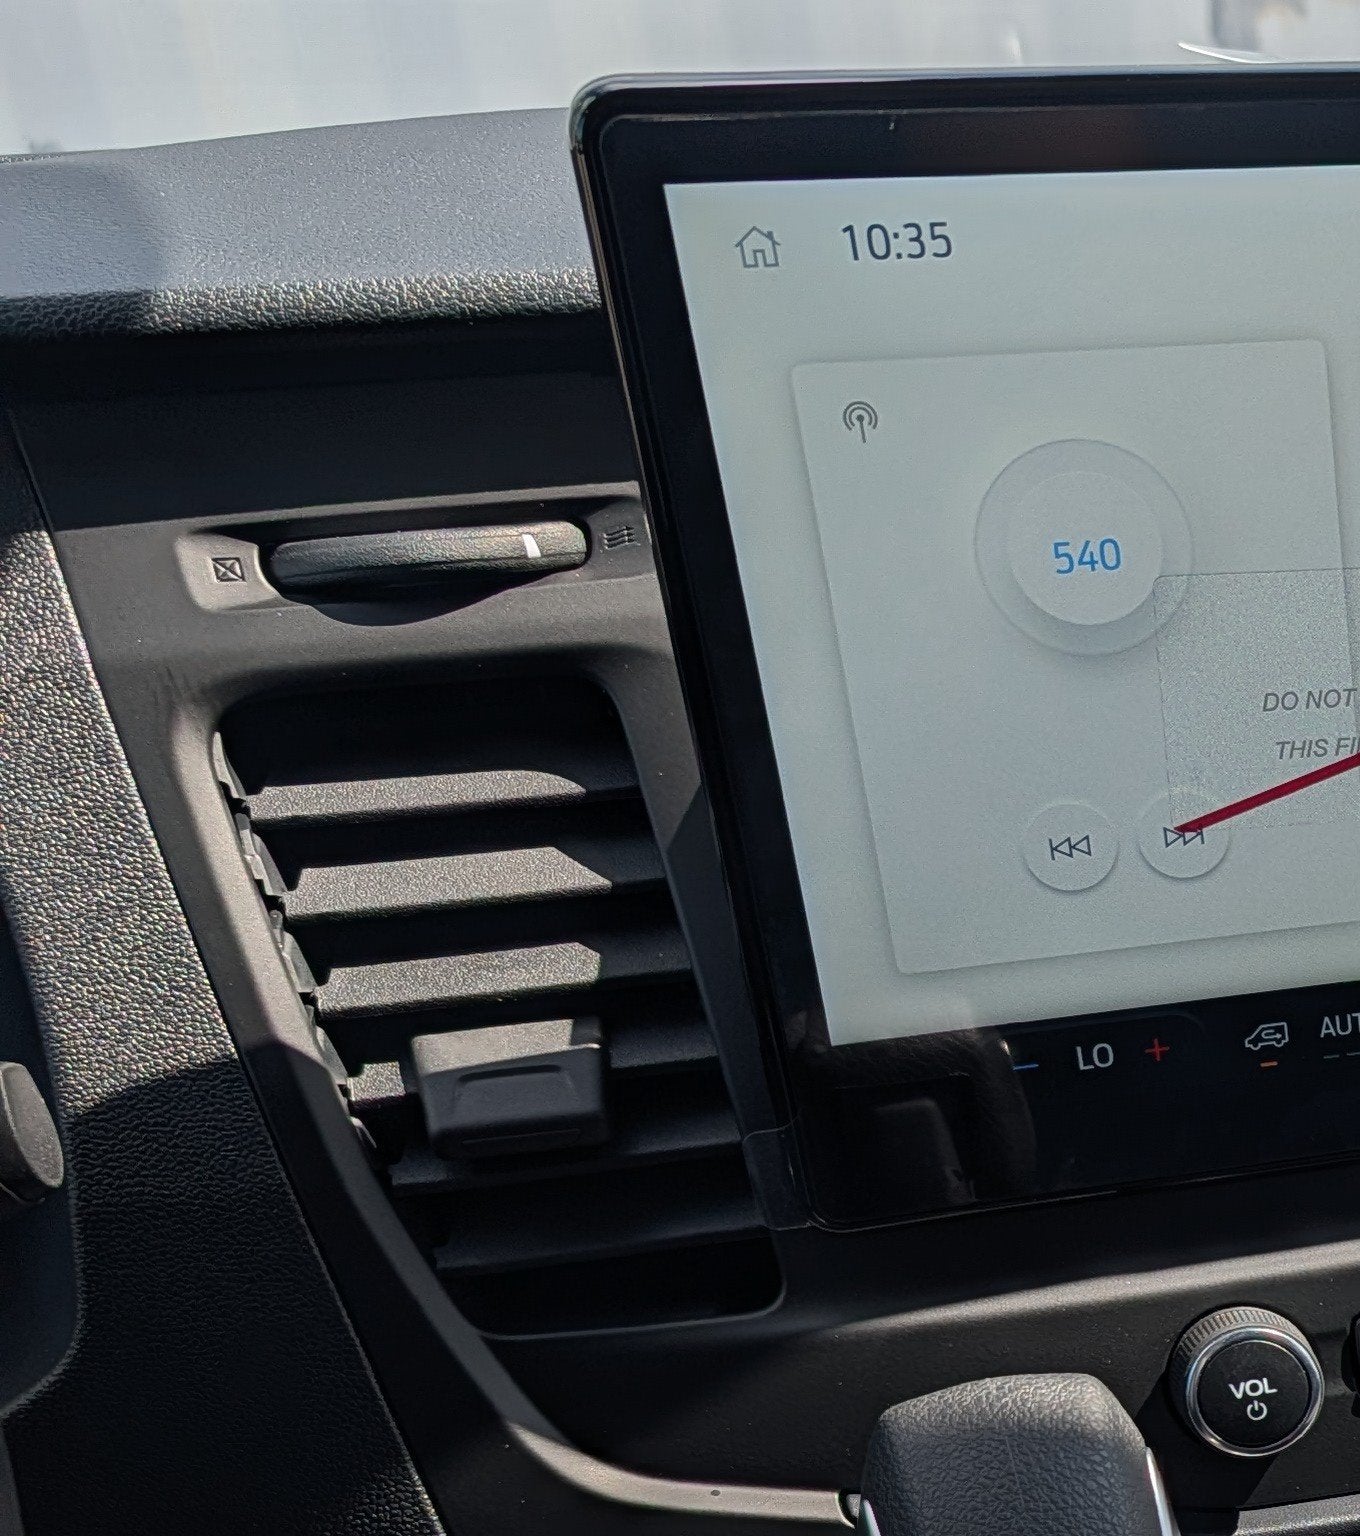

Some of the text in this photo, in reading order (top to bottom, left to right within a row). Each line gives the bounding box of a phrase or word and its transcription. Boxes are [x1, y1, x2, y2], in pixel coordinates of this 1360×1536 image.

[841, 221, 953, 262] 10:35
[1052, 538, 1122, 575] 540
[1262, 691, 1299, 712] DO
[1305, 688, 1357, 710] NOT
[1276, 738, 1329, 760] THIS
[1074, 1042, 1115, 1072] LO
[1228, 1376, 1278, 1399] VOL
